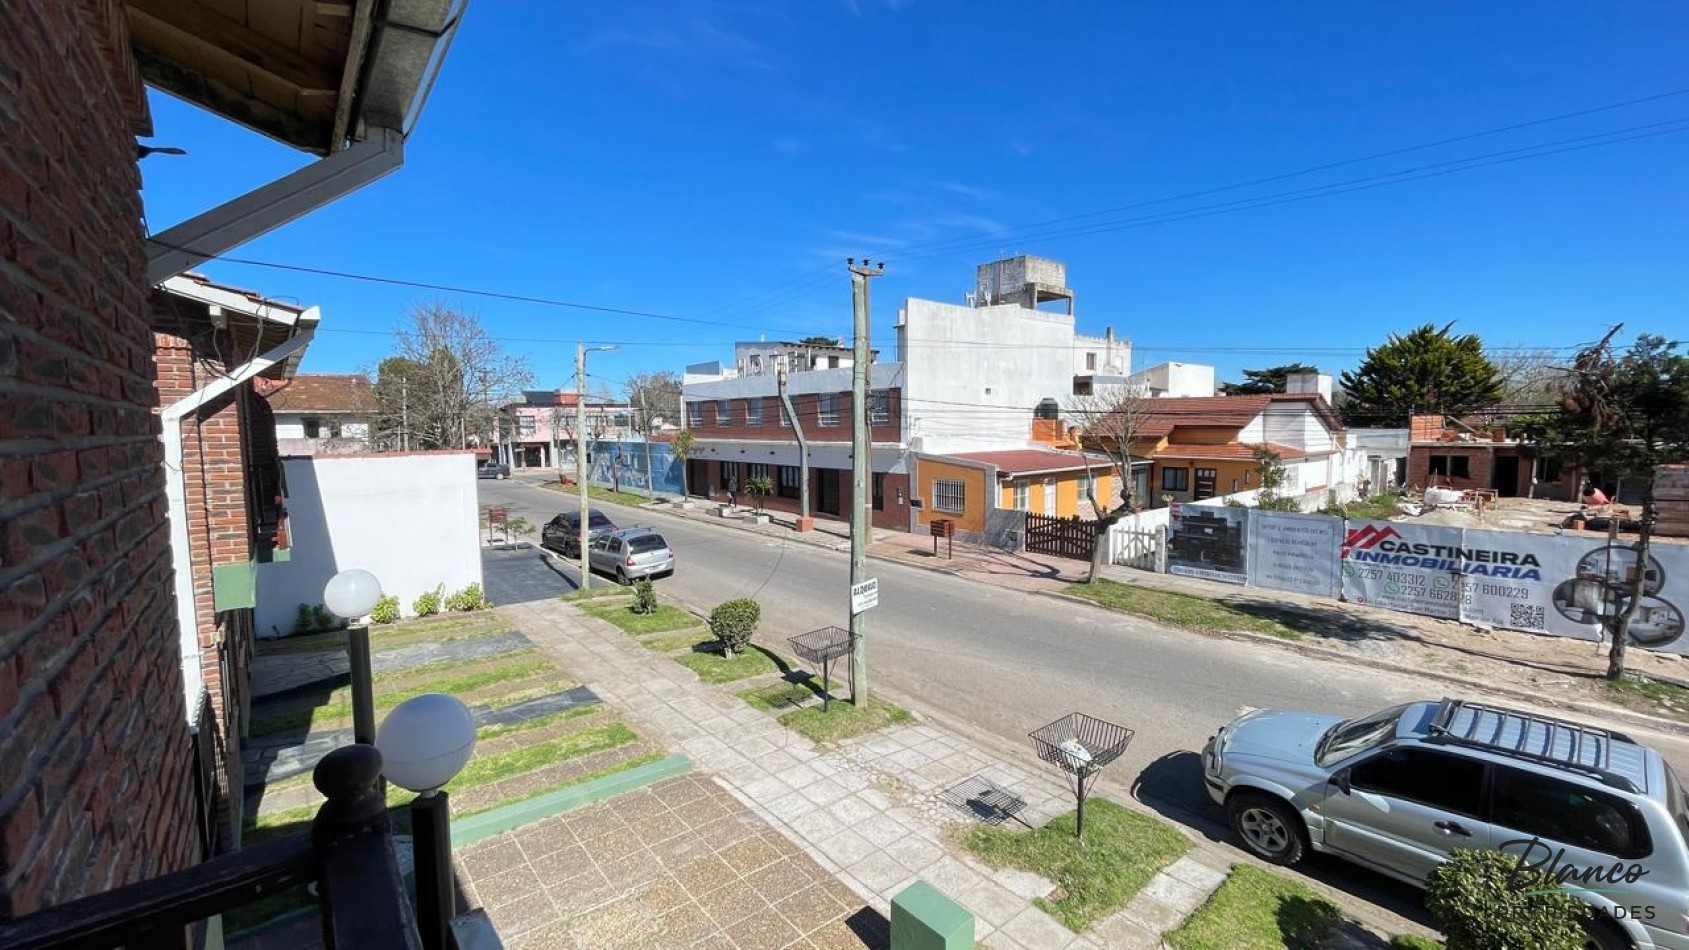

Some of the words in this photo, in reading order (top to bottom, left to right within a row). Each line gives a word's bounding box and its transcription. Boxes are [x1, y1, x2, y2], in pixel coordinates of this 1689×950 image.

[1355, 550, 1541, 581] INMOBILIARIA
[1358, 568, 1383, 580] 2257
[1387, 572, 1426, 587] 403312
[1401, 585, 1426, 597] 2257
[1482, 584, 1529, 599] 600229
